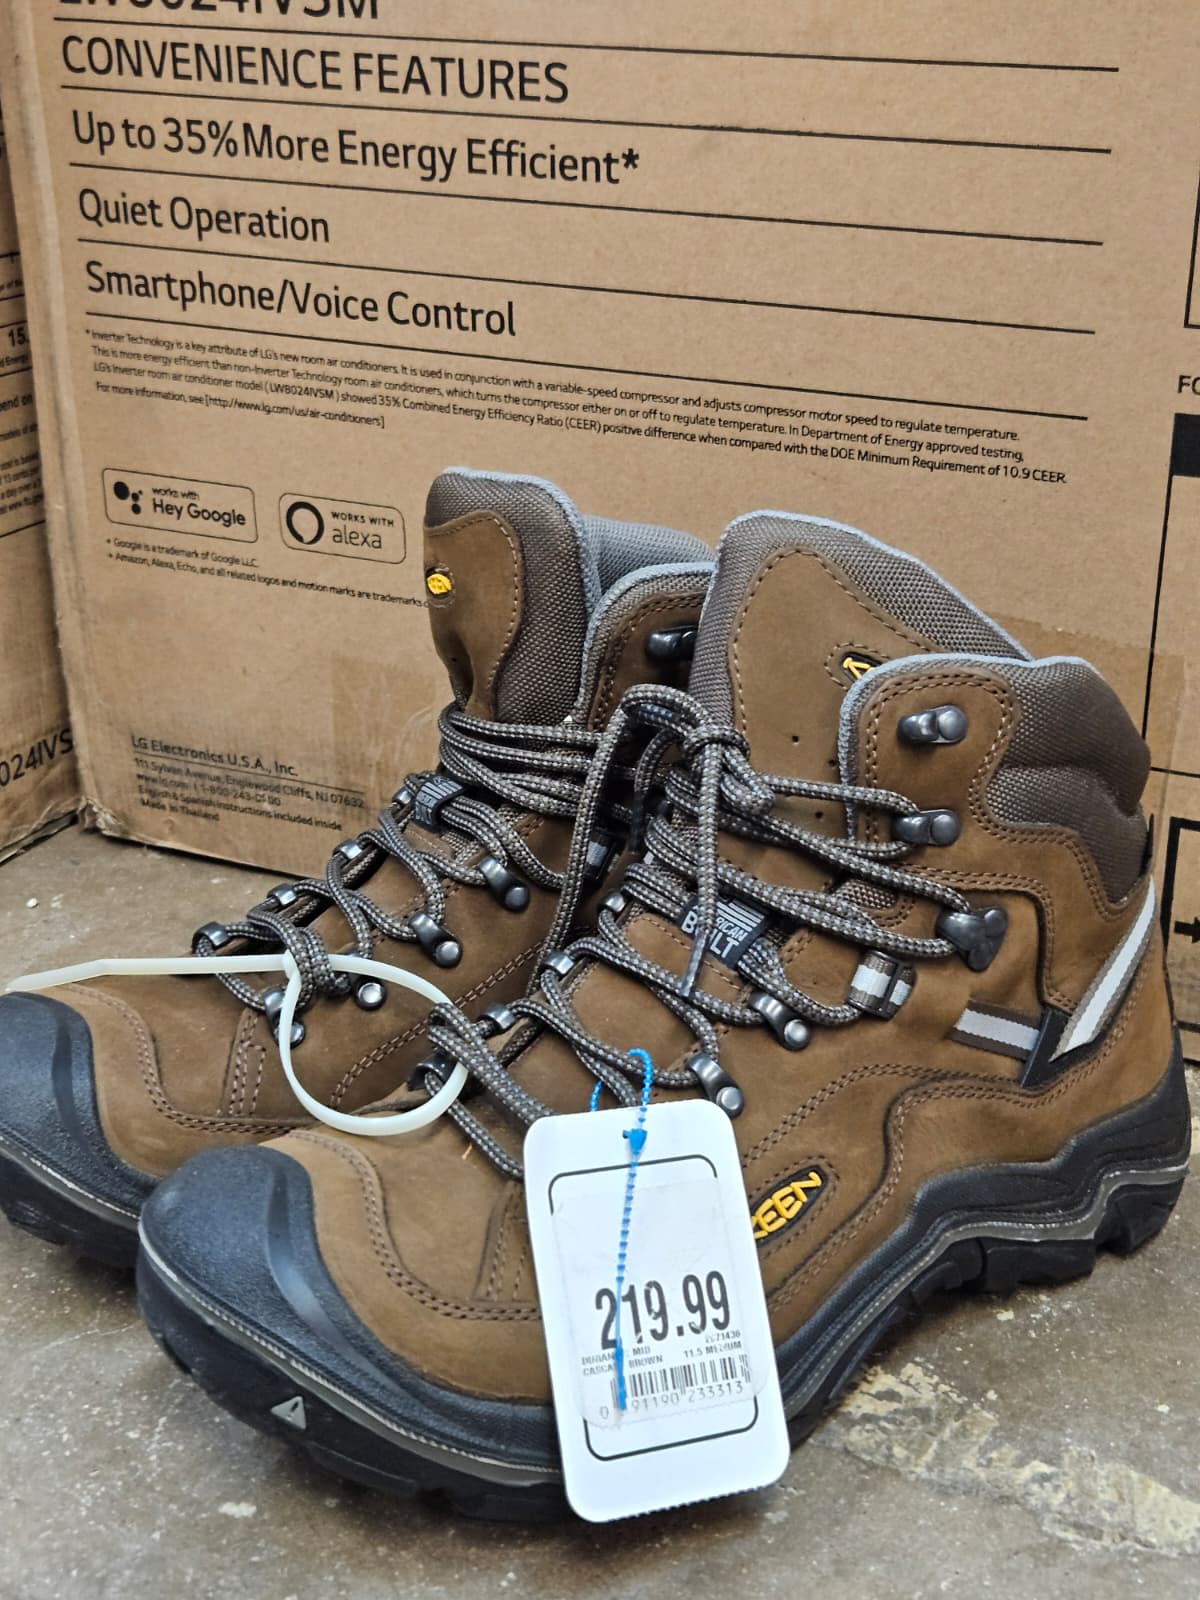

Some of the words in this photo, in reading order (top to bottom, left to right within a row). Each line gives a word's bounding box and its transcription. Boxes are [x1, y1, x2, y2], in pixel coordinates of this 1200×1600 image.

[62, 35, 342, 91] CONVENIENCE
[353, 52, 569, 104] FEATURES
[73, 110, 116, 156] Up
[123, 122, 156, 150] to
[163, 117, 239, 157] 35%
[243, 123, 330, 163] More
[338, 129, 457, 183] Energy
[79, 188, 163, 228] Quiet
[170, 197, 330, 242] Operation
[86, 261, 379, 322] Smartphone/Voice
[387, 292, 517, 337] Control
[120, 351, 141, 361] more
[143, 353, 171, 367] energy
[174, 355, 211, 369] efficient
[211, 357, 233, 370] than
[292, 368, 342, 387] Technology
[344, 376, 370, 387] room
[371, 379, 383, 388] air
[446, 388, 475, 401] which
[476, 391, 503, 404] turns
[504, 393, 521, 405] the
[522, 398, 580, 412] compressor
[582, 403, 613, 416] either
[614, 408, 628, 417] on
[630, 410, 641, 419] or
[642, 408, 658, 420] off
[659, 411, 671, 422] to
[673, 413, 717, 427] regulate
[790, 423, 800, 436] In
[801, 425, 869, 443] Department
[870, 433, 883, 445] of
[884, 435, 925, 452] Energy
[926, 440, 979, 455] approved
[127, 333, 174, 351] Technology
[192, 341, 206, 354] key
[208, 344, 248, 358] attribute
[250, 347, 259, 357] of
[280, 353, 299, 363] new
[301, 355, 326, 365] room
[327, 358, 339, 366] air
[411, 366, 418, 376] is
[420, 368, 443, 379] used
[445, 370, 454, 379] in
[455, 372, 512, 386] conjunction
[513, 378, 535, 391] with
[537, 382, 543, 391] a
[546, 382, 618, 399] variable-speed
[620, 389, 680, 406] compressor
[682, 396, 702, 408] and
[703, 398, 741, 412] adjusts
[744, 403, 807, 418] compressor
[809, 410, 843, 423] motor
[845, 414, 878, 427] speed
[881, 417, 894, 428] to
[896, 418, 943, 433] regulate
[148, 370, 170, 379] room
[172, 373, 183, 381] air
[184, 375, 233, 387] conditioner
[235, 379, 263, 391] model
[341, 392, 378, 405] showed
[379, 395, 401, 407] 35%
[402, 398, 451, 414] Combined
[452, 404, 486, 421] Energy
[488, 408, 535, 426] Efficiency
[536, 414, 564, 427] Ratio
[565, 416, 602, 434] (CEER)
[603, 423, 643, 435] positive
[644, 427, 697, 442] difference
[699, 432, 728, 446] when
[729, 437, 782, 452] compared
[784, 443, 807, 455] with
[810, 445, 828, 457] the
[830, 447, 855, 460] DOE
[857, 450, 910, 466] Minimum
[911, 456, 985, 475] Requirement
[986, 465, 1001, 476] of
[1002, 466, 1030, 480] 10.9
[152, 487, 179, 499] works
[180, 490, 200, 501] with
[152, 498, 184, 521] Hey
[187, 502, 247, 528] Google
[331, 511, 366, 524] WORKS
[368, 516, 395, 528] WITH
[332, 524, 383, 550] alexa
[113, 538, 142, 551] Google
[157, 546, 199, 559] trademark
[201, 551, 210, 560] of
[210, 551, 240, 566] Google
[200, 566, 216, 576] and
[216, 568, 226, 577] all
[226, 570, 256, 582] related
[257, 574, 280, 587] logos
[281, 579, 297, 588] and
[298, 582, 329, 593] motion
[330, 585, 356, 597] marks
[357, 590, 372, 600] are
[372, 592, 423, 608] trademarks
[131, 735, 150, 750] LG
[152, 739, 224, 764] Electronics
[681, 910, 739, 958] BILT
[595, 1270, 731, 1350] 219.99
[583, 1364, 614, 1376] CASCA
